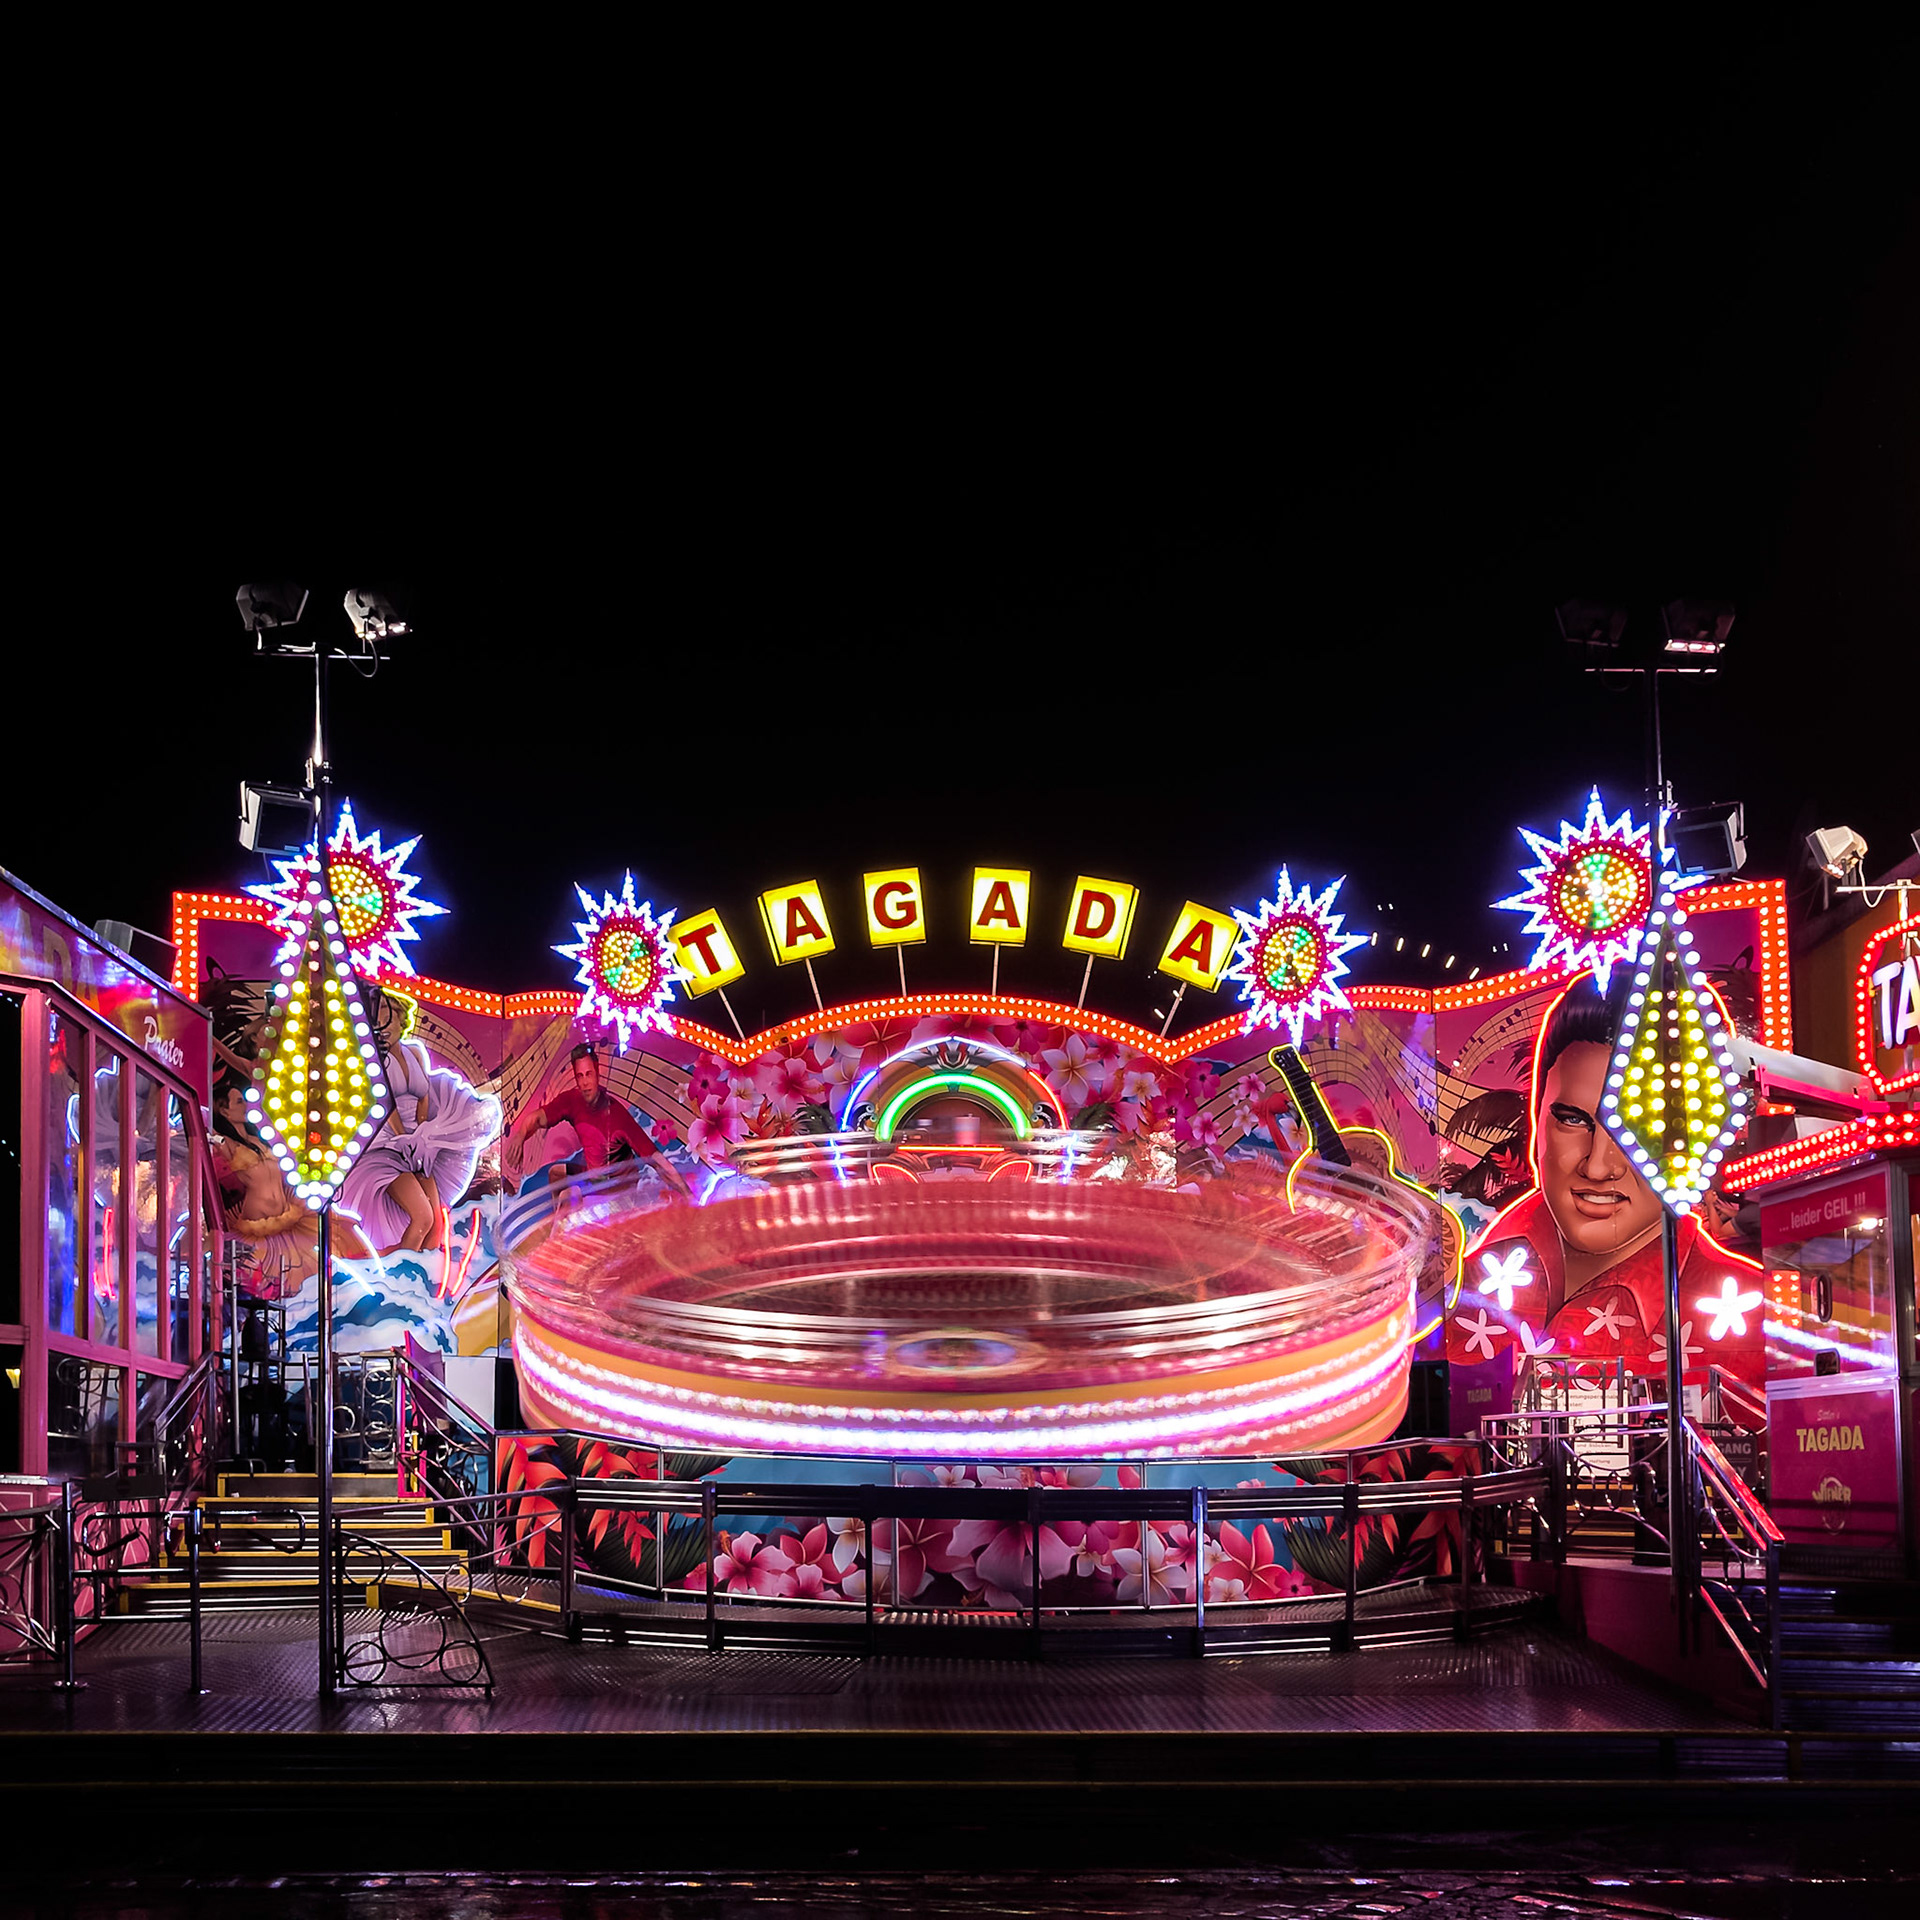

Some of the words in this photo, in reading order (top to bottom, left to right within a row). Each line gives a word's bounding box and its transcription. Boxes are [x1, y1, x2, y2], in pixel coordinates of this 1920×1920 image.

[678, 880, 1214, 975] TAGADA
[143, 1016, 185, 1068] Prater
[1791, 1207, 1822, 1230] leider
[1824, 1197, 1852, 1220] GEIL
[1796, 1425, 1865, 1452] TAGADA
